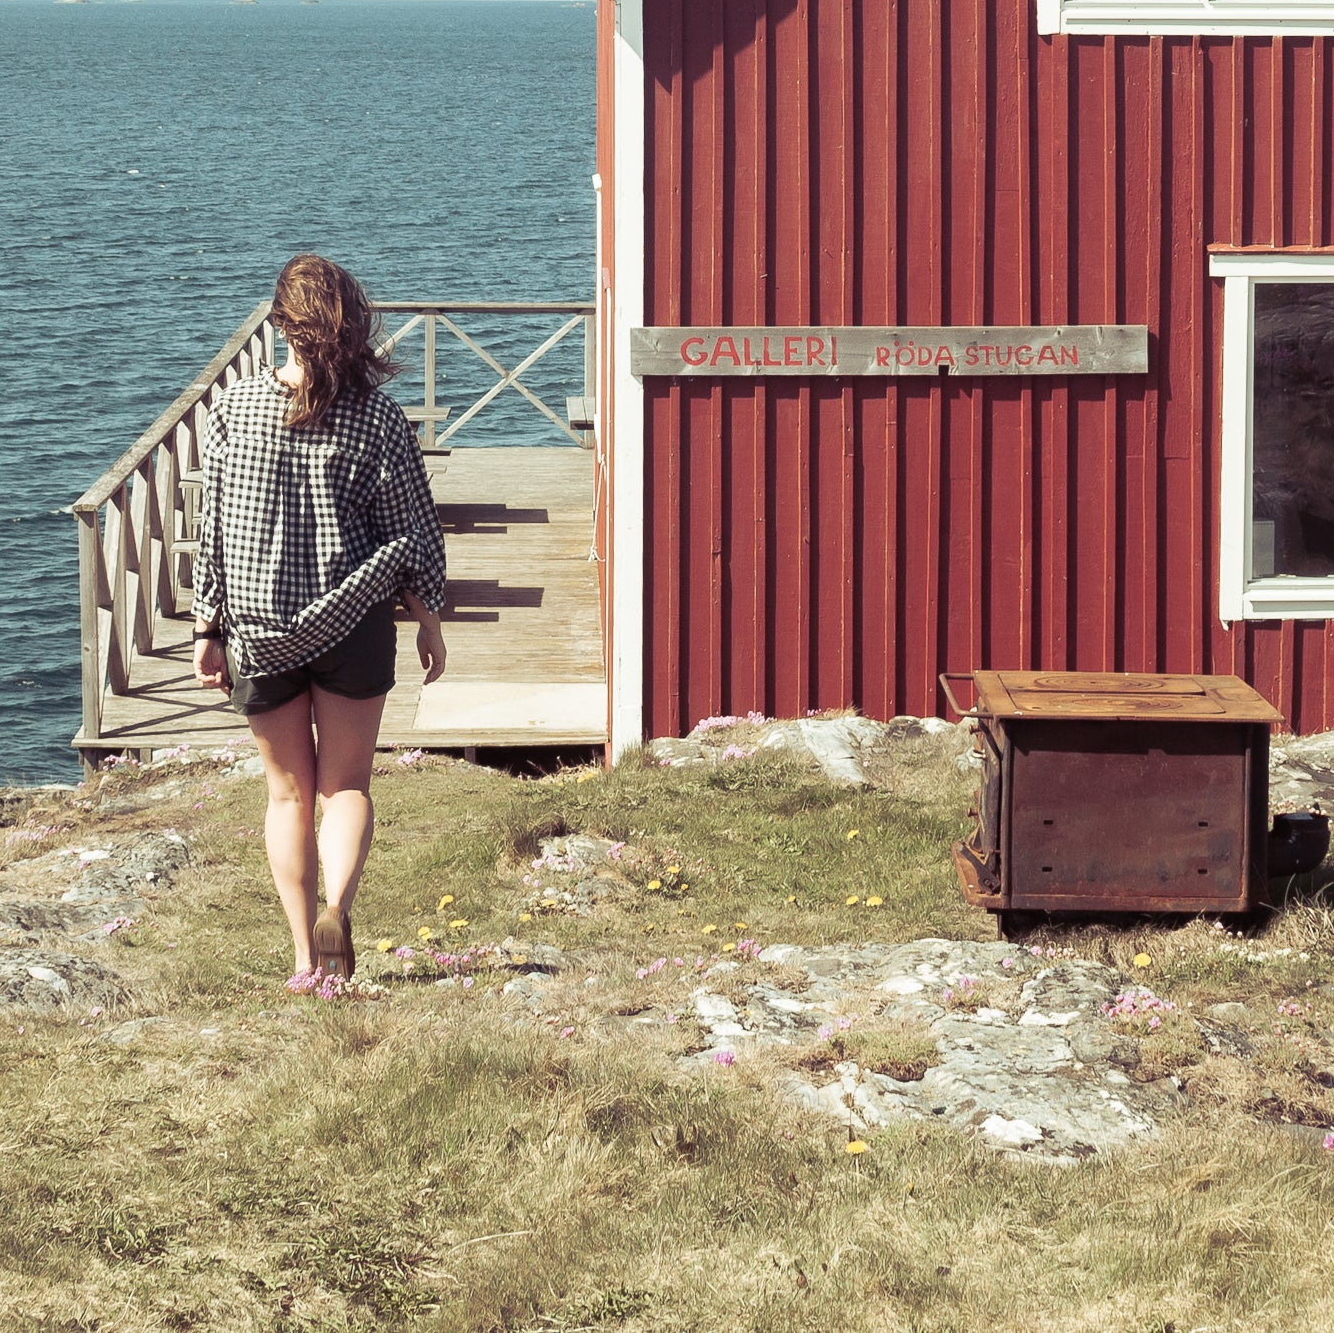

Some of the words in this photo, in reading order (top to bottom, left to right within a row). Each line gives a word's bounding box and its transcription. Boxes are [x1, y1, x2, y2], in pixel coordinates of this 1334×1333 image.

[680, 335, 838, 367] GALLERI
[876, 340, 955, 367] RÖDA
[965, 344, 1079, 366] STUGAN
